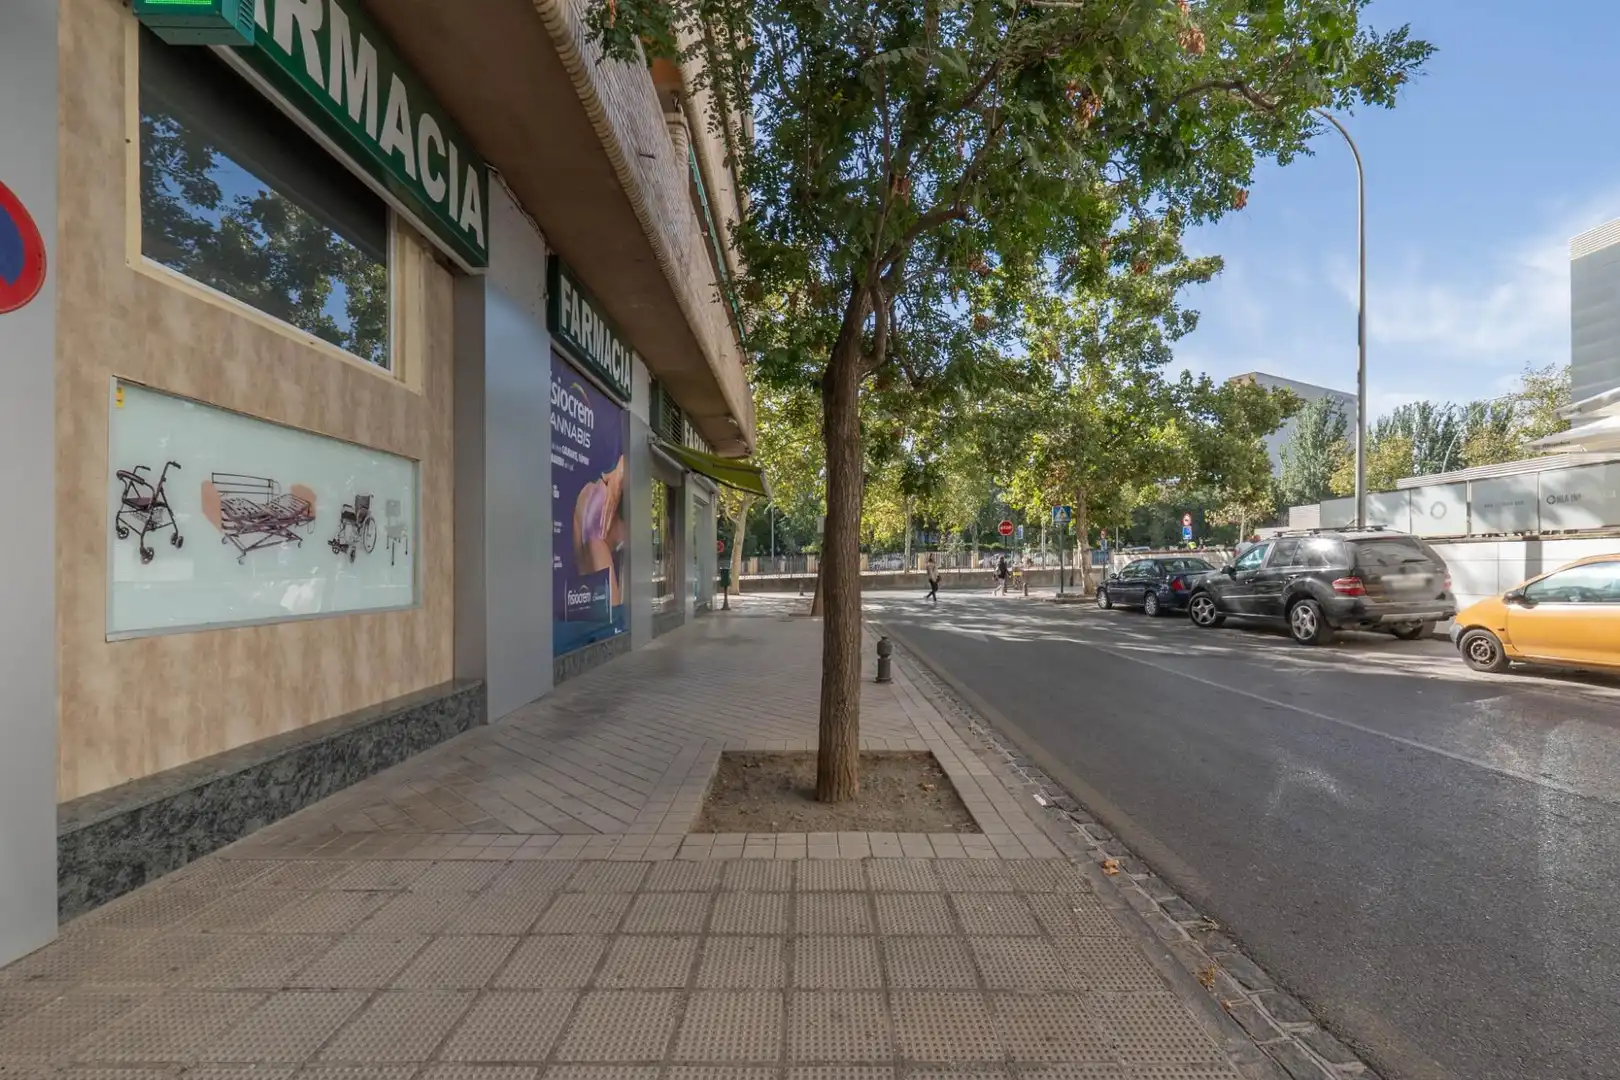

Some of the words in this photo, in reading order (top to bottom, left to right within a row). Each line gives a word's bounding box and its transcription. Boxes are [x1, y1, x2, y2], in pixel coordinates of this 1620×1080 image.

[254, 0, 485, 250] RMACIA
[561, 274, 631, 394] FARMACIA
[551, 376, 594, 430] siocrem
